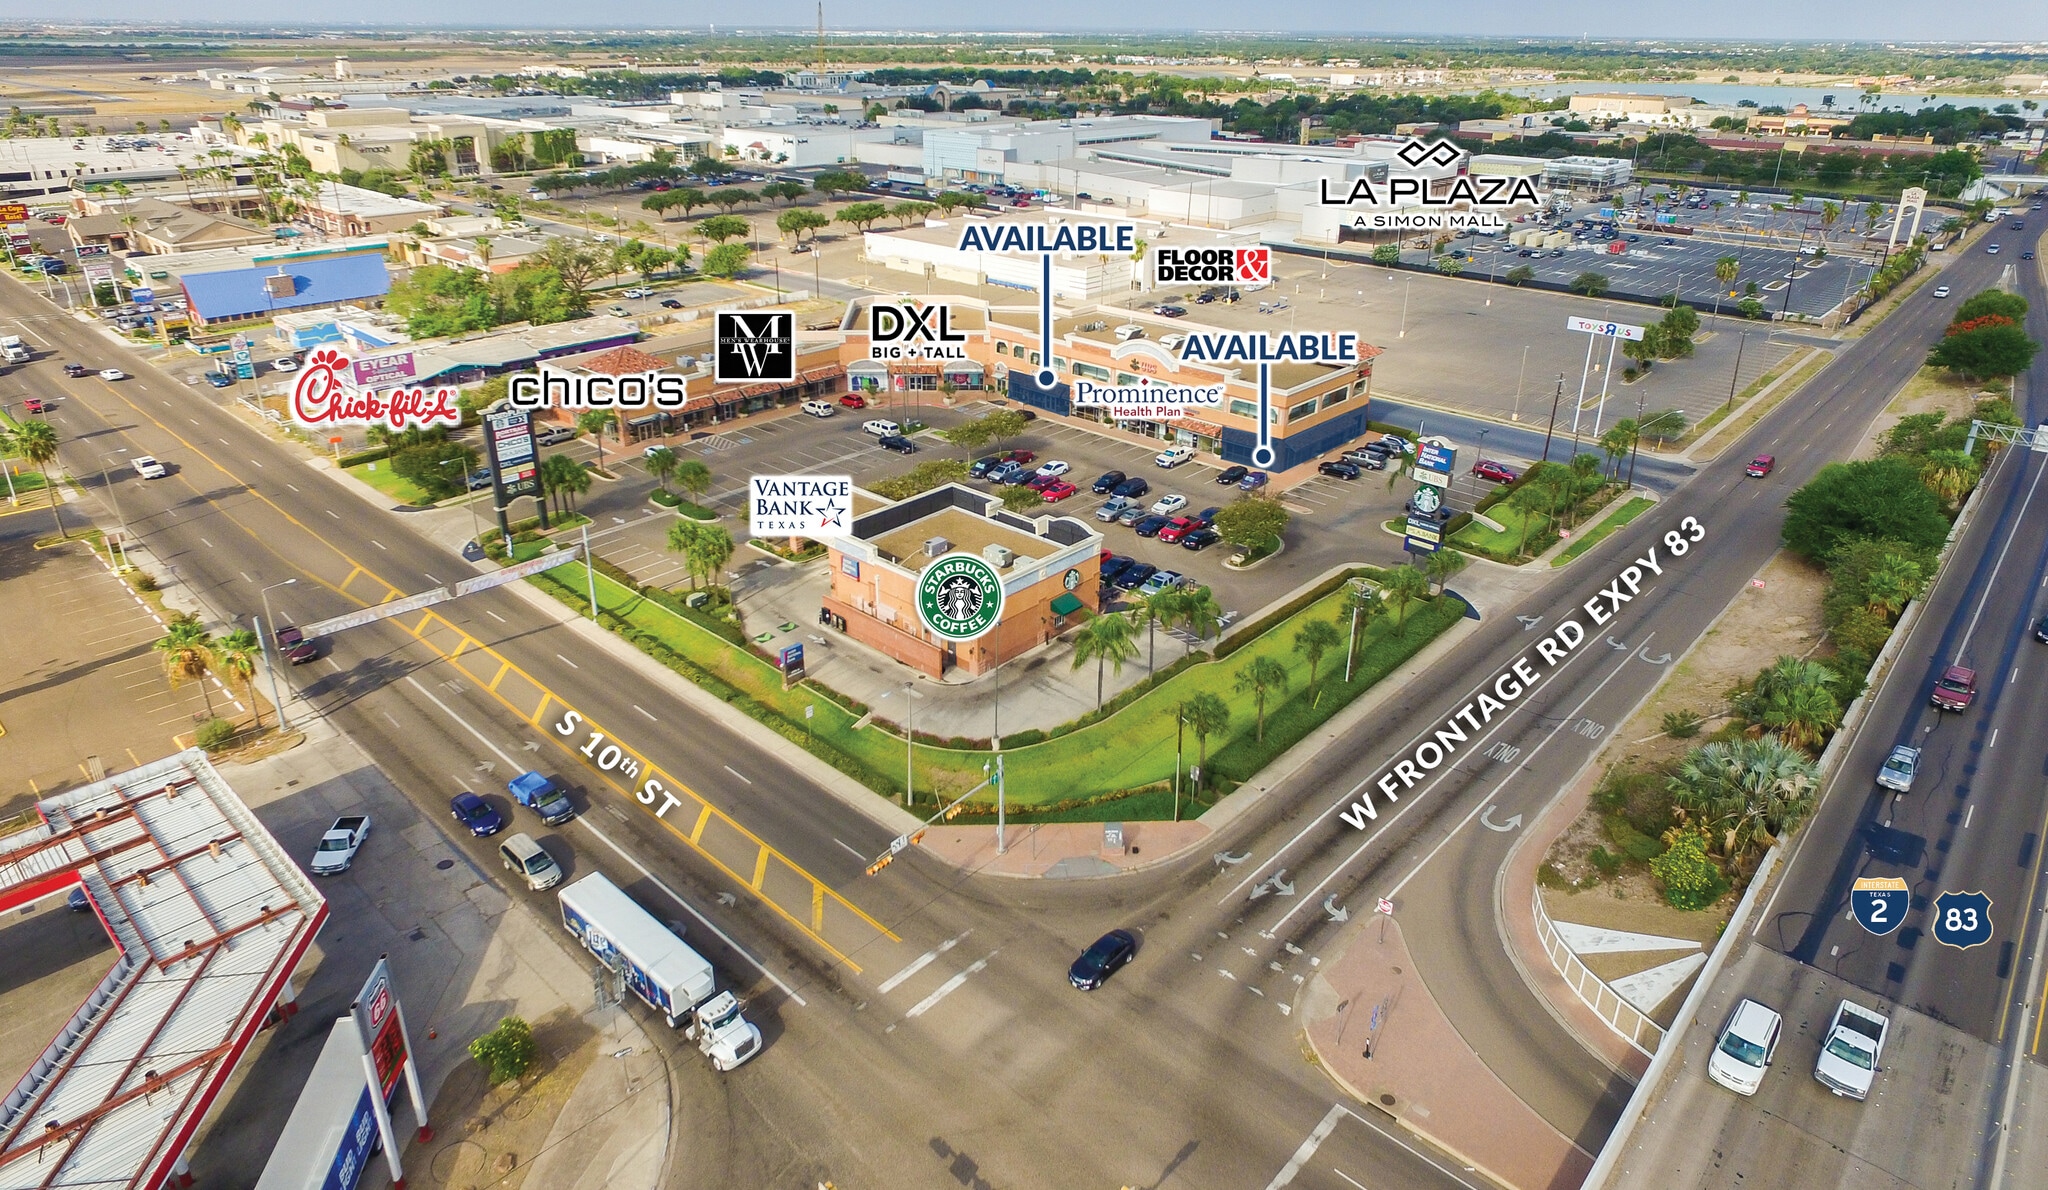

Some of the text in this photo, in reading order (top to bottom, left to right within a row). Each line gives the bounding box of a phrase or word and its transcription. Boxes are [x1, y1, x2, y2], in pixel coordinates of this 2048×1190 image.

[1579, 321, 1604, 333] TOYS
[1617, 328, 1632, 337] US
[360, 354, 409, 371] EYEAR
[365, 370, 408, 383] OPTICAL
[1422, 446, 1440, 455] INTER
[1418, 457, 1435, 467] BANK
[1420, 451, 1447, 464] NATIONAL
[1428, 473, 1443, 484] UBS
[517, 480, 535, 491] UBS
[1571, 717, 1605, 740] ONLY
[1483, 741, 1521, 764] ONLY
[374, 992, 387, 1021] 66
